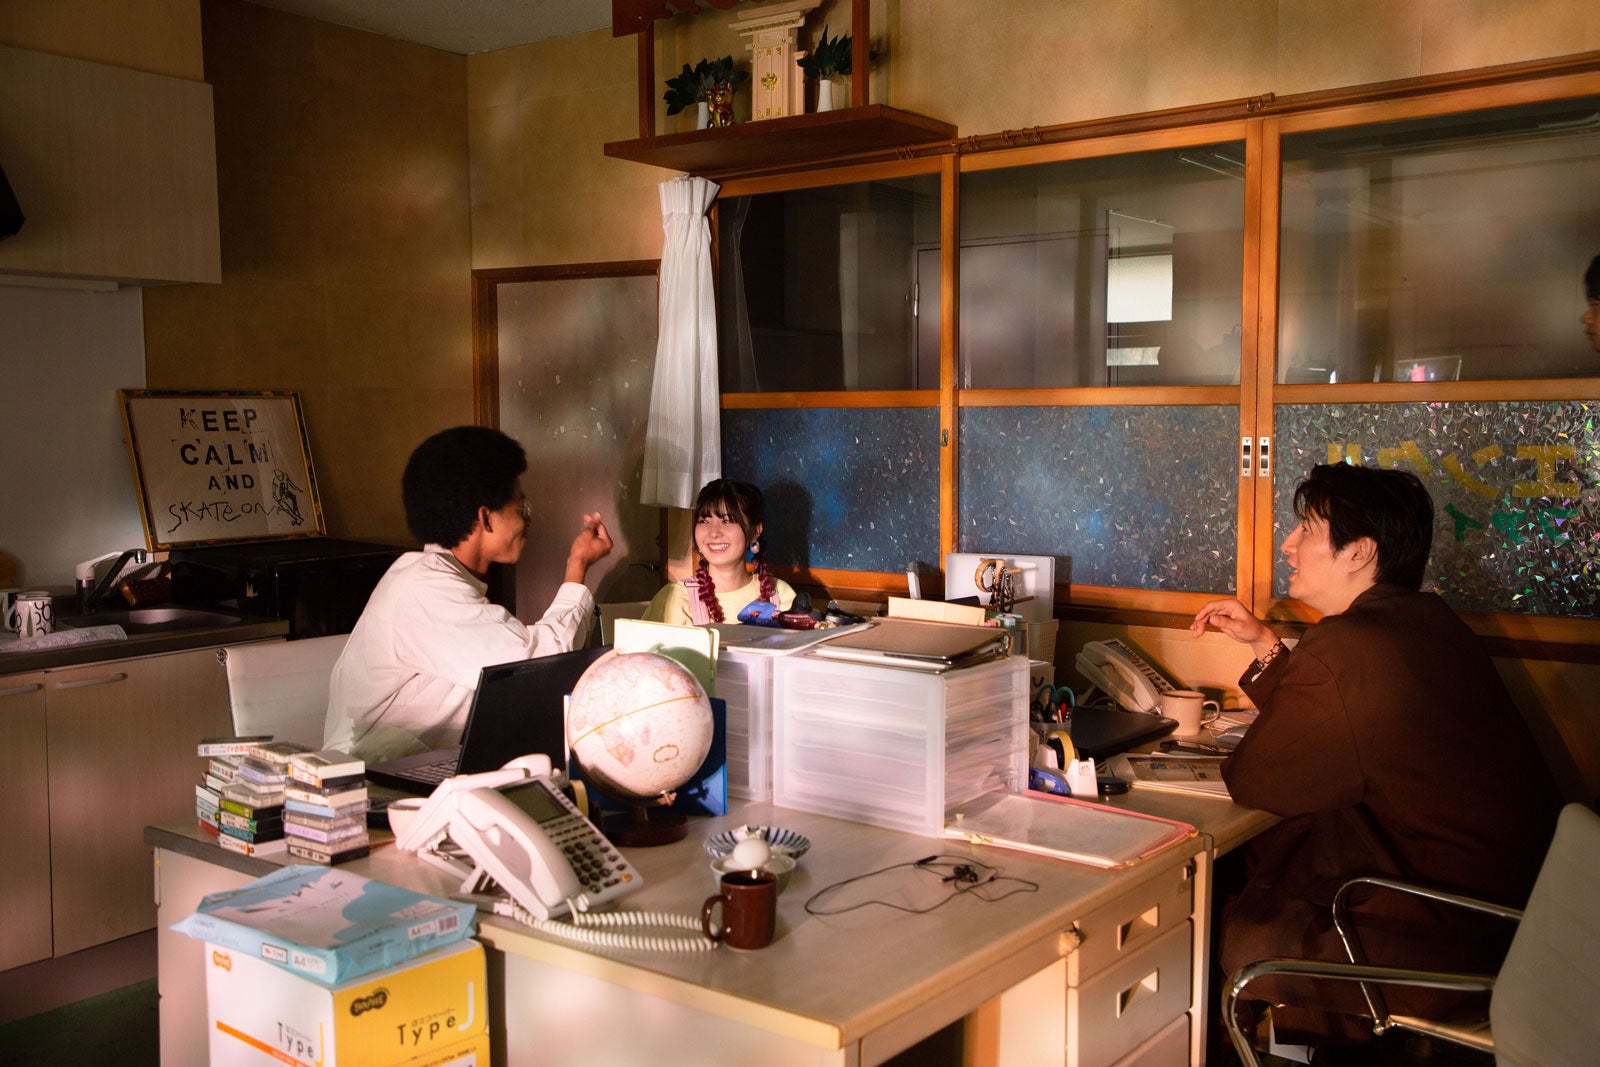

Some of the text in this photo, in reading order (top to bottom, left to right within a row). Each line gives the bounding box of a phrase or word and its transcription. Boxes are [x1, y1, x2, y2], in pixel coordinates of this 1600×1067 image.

[179, 408, 257, 431] KEEP
[180, 441, 269, 465] CALM
[208, 474, 255, 490] AND
[277, 1021, 314, 1059] Type
[397, 1016, 456, 1046] Type
